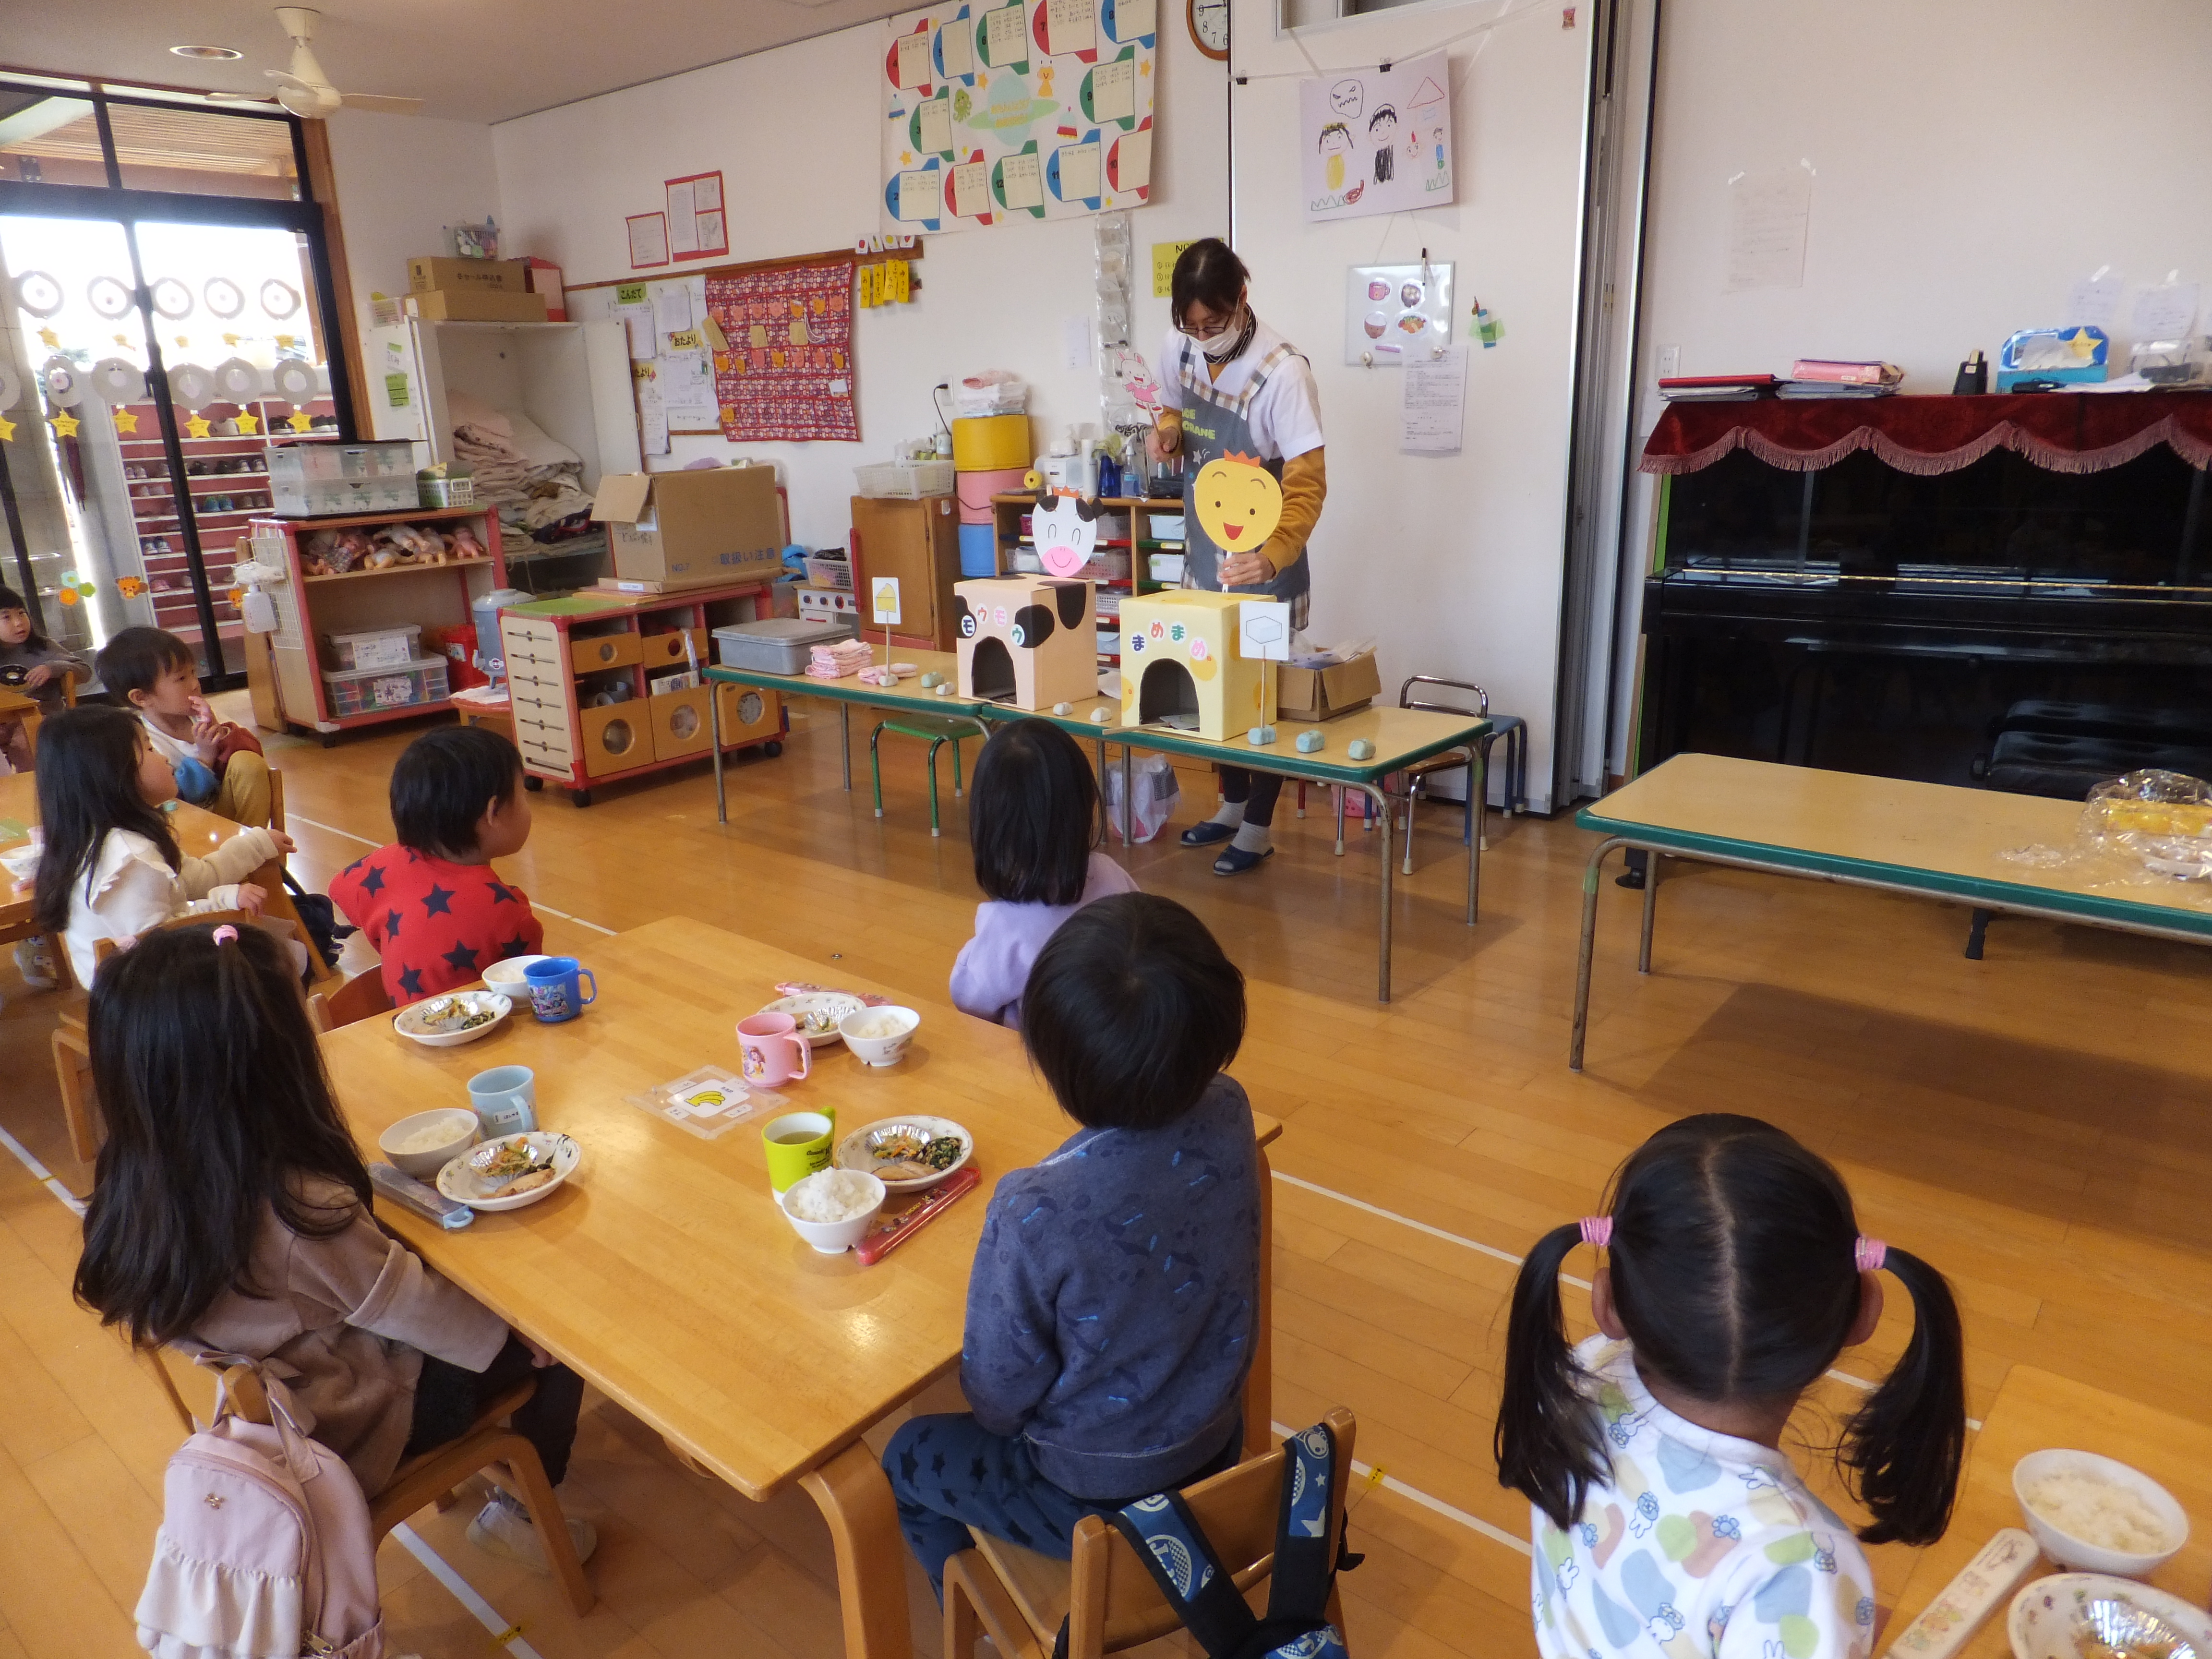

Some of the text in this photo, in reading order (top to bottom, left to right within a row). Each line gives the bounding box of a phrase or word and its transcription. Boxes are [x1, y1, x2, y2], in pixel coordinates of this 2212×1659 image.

[1199, 4, 1204, 17] 9
[1040, 22, 1046, 31] 7
[1202, 21, 1208, 33] 8
[982, 36, 986, 45] 6
[1212, 31, 1217, 44] 7
[1223, 33, 1228, 46] 6
[1052, 170, 1059, 180] 11
[996, 179, 1004, 188] 12
[894, 192, 899, 201] 2
[621, 288, 641, 300] こんだて
[674, 334, 696, 346] おたより
[634, 367, 651, 378] たより
[963, 607, 1022, 643] モウモウ
[1132, 622, 1206, 658] まめまめ
